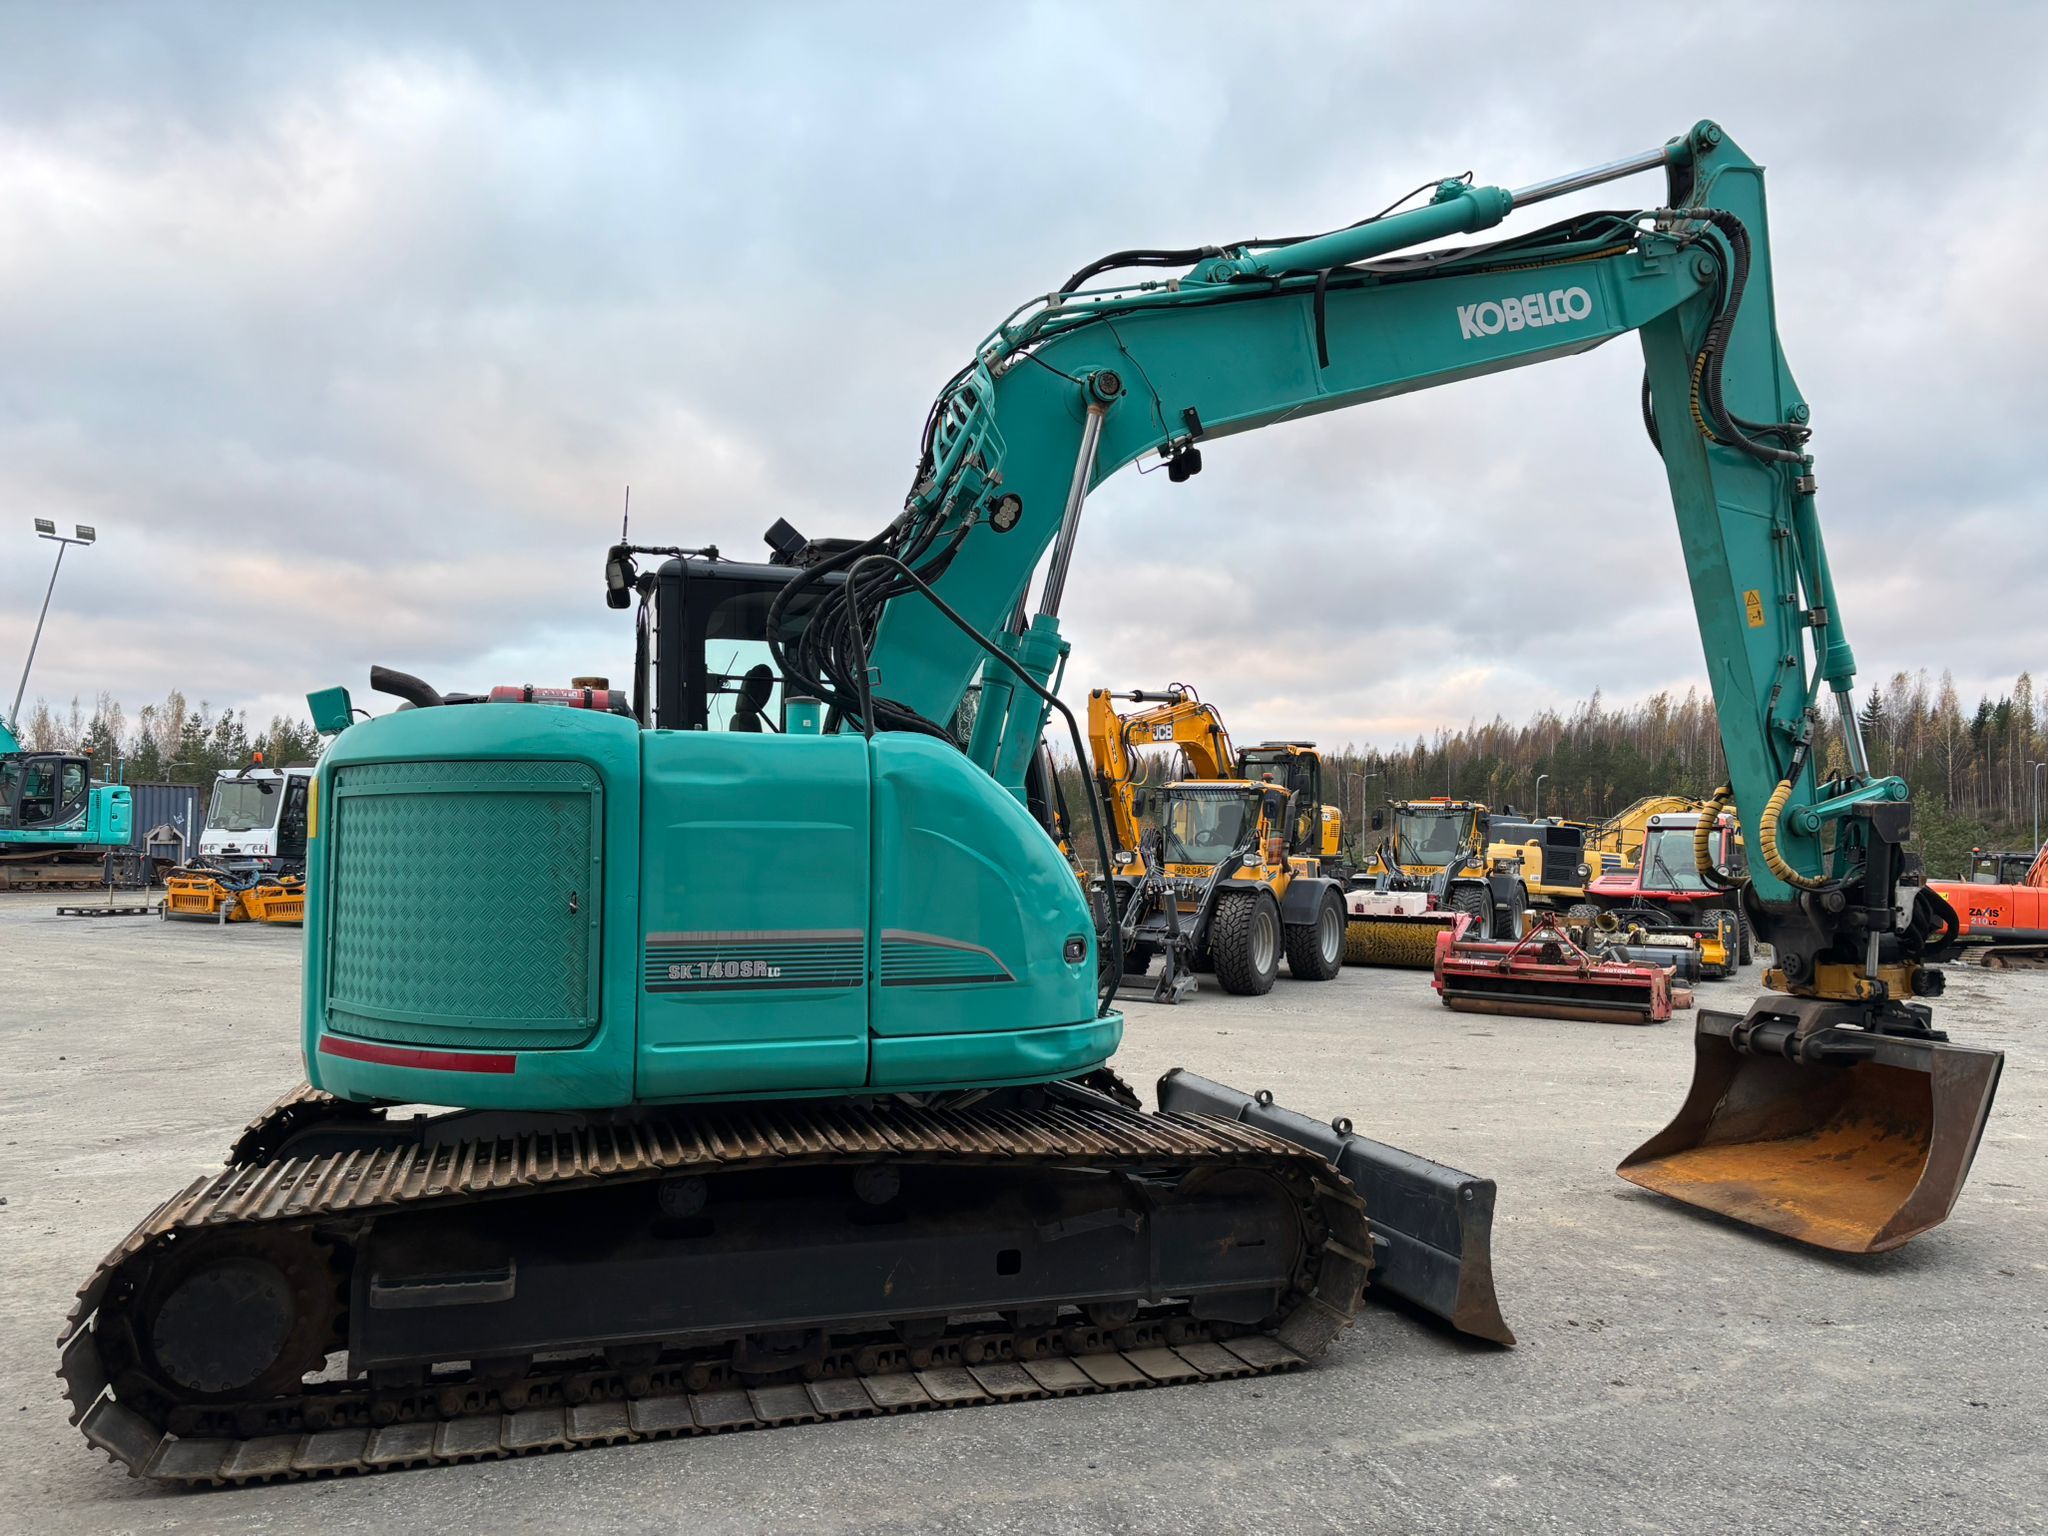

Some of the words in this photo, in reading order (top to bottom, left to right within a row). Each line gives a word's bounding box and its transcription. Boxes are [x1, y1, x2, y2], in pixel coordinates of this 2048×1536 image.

[1457, 287, 1592, 340] KOBELCO
[1153, 724, 1173, 740] JCB
[668, 965, 692, 979] SK
